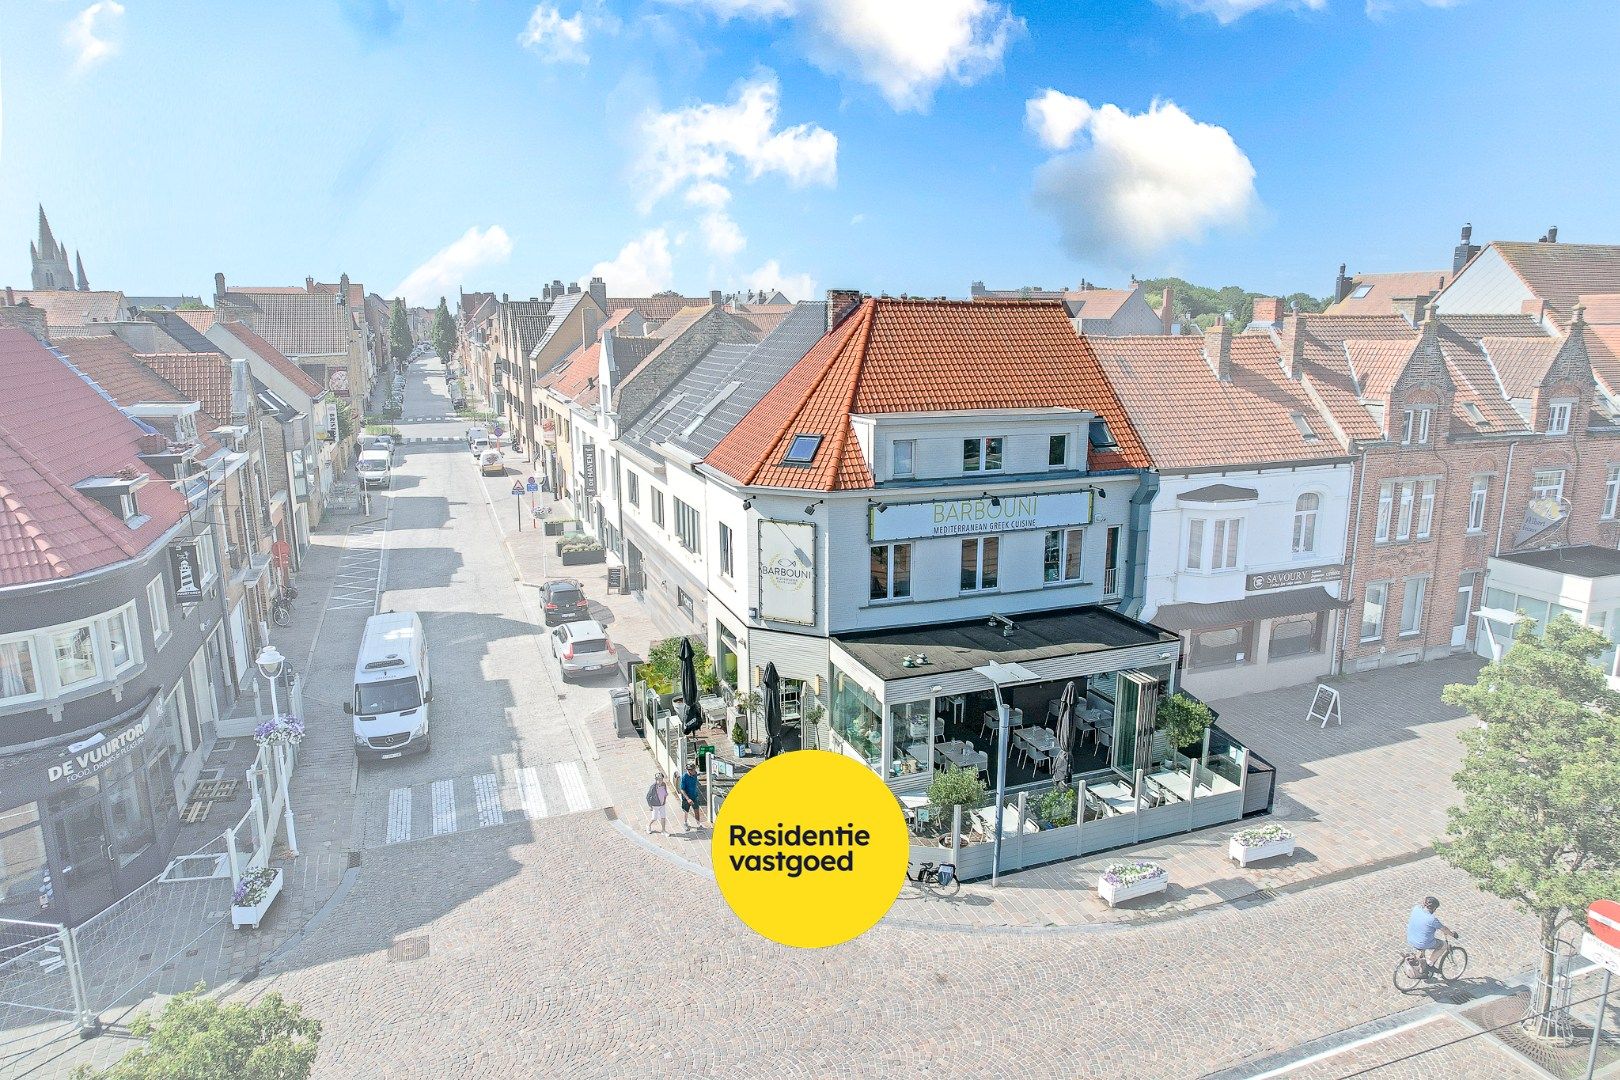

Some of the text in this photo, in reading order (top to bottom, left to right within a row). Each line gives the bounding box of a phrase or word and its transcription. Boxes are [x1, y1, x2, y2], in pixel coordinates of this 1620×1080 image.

[586, 454, 594, 478] HAVEN
[933, 498, 1037, 524] BARBOUNI
[933, 518, 1036, 534] MEDITERRANEAN GREEK CUISINE
[762, 566, 811, 579] BARBOUNI
[1266, 571, 1308, 584] SAVOURY
[48, 760, 74, 782] DE
[93, 755, 116, 772] DRINKS
